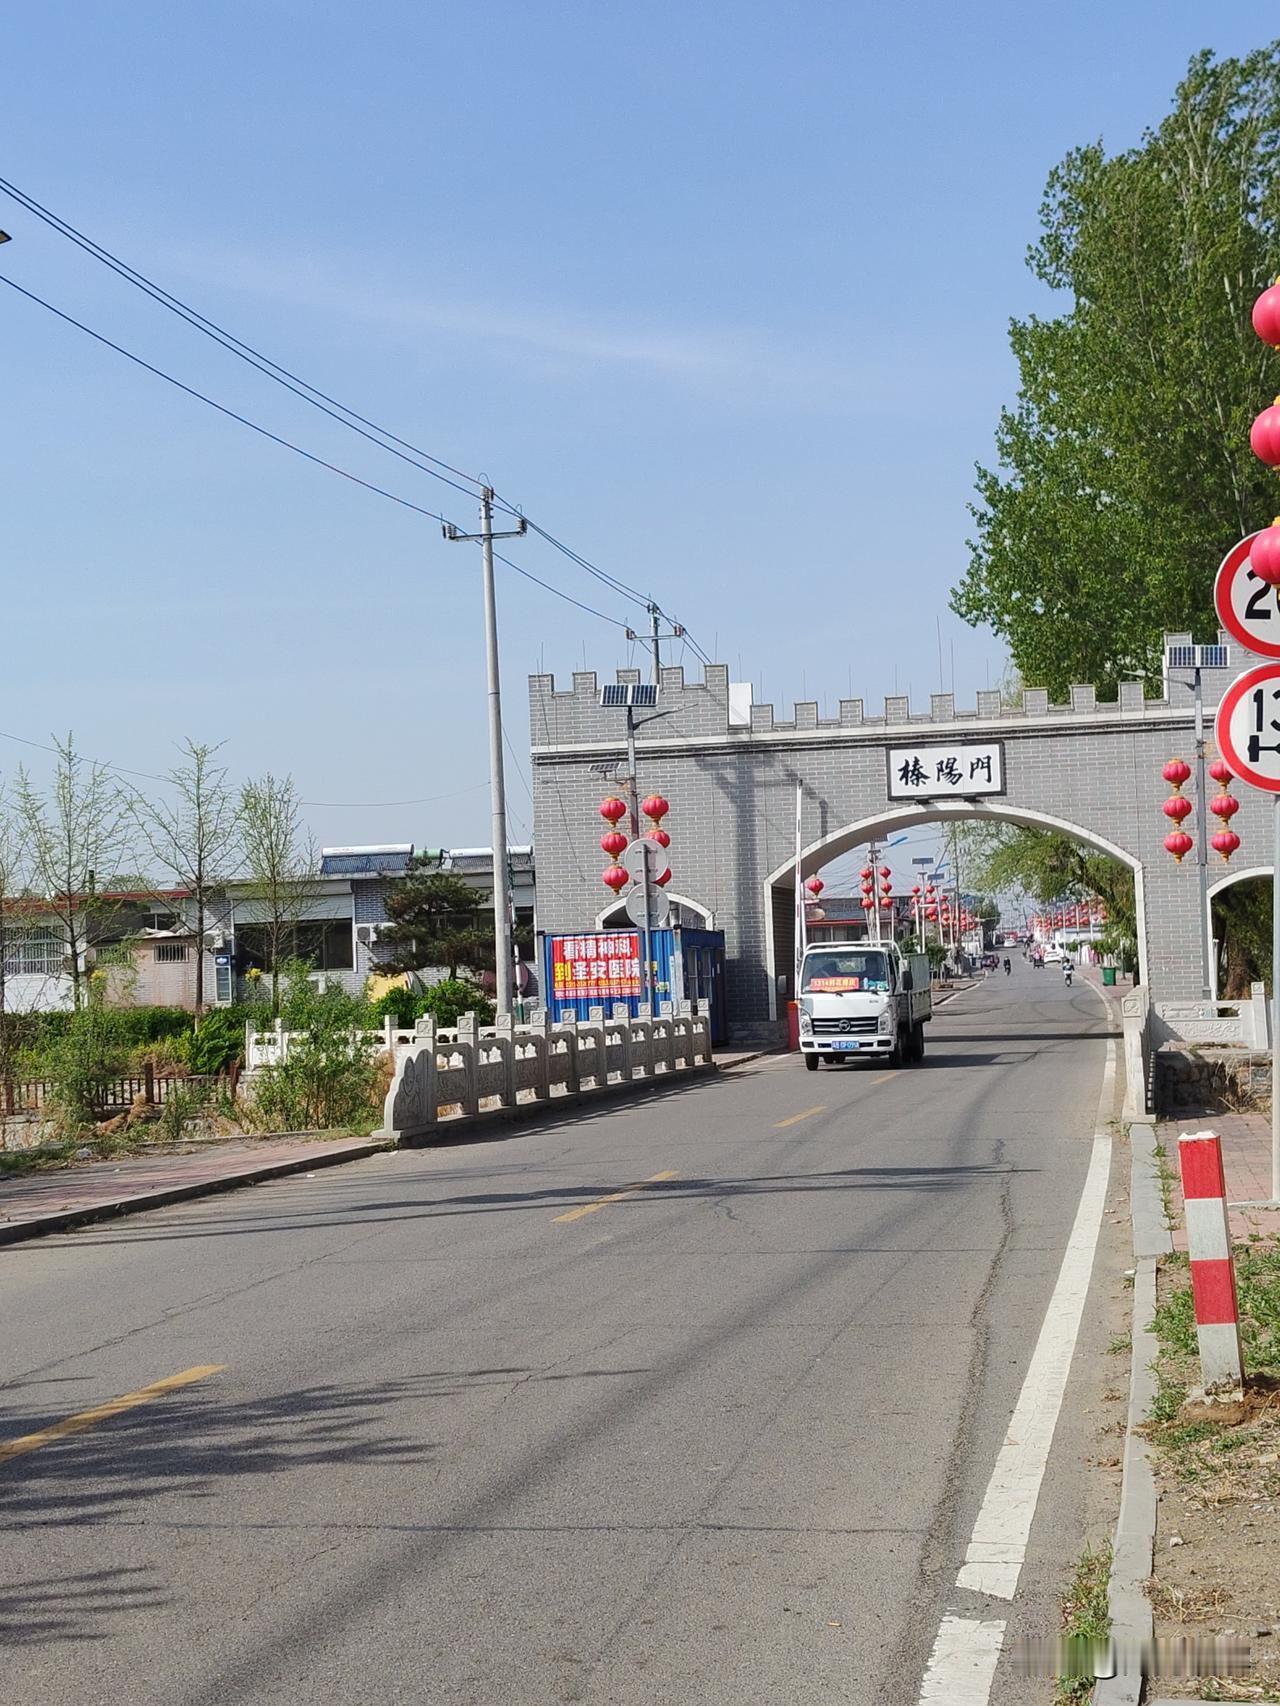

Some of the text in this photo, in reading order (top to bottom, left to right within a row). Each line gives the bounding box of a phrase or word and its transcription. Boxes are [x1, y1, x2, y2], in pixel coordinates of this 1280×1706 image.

[1244, 569, 1280, 621] 2
[897, 754, 993, 787] 榛陽門
[563, 938, 633, 960] 看精神科
[554, 958, 640, 982] 到圣安医院
